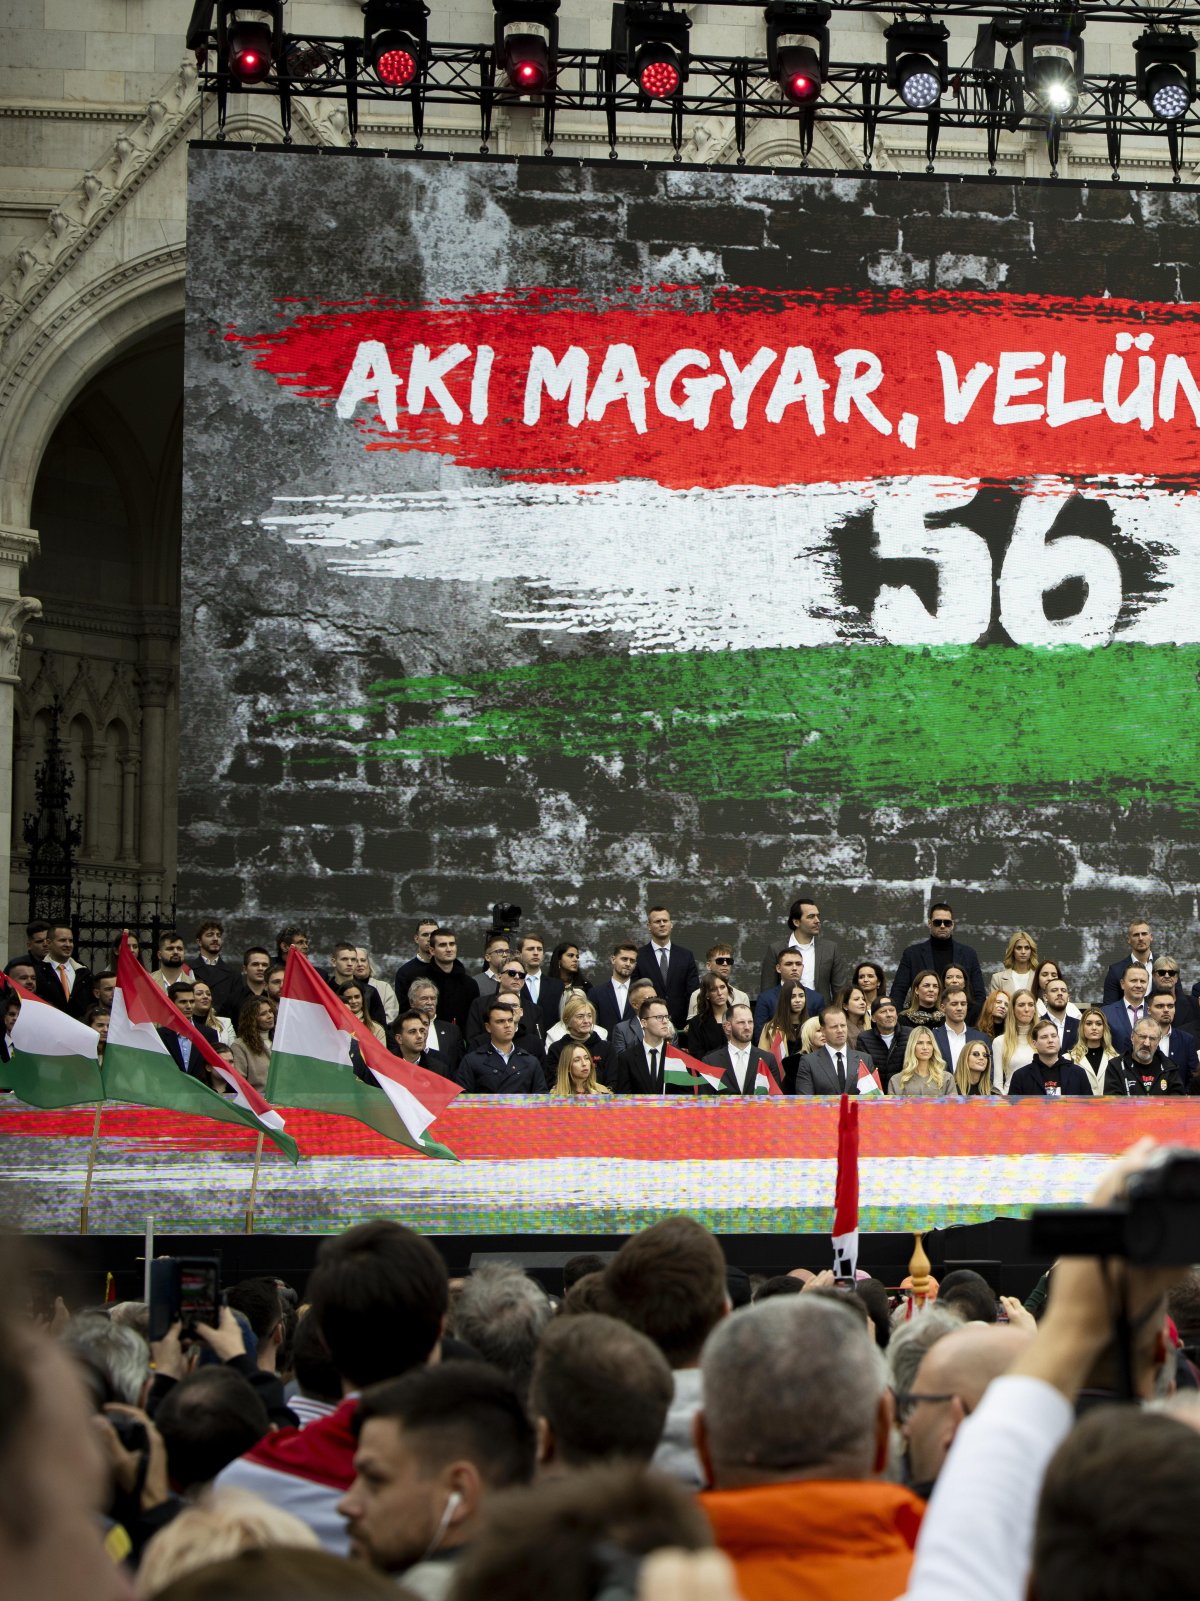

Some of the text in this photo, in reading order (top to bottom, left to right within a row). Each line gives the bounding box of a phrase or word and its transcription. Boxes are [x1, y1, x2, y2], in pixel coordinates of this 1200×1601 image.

[335, 340, 495, 432] AKI
[523, 344, 918, 449] MAGYAR,
[871, 475, 1122, 647] 56
